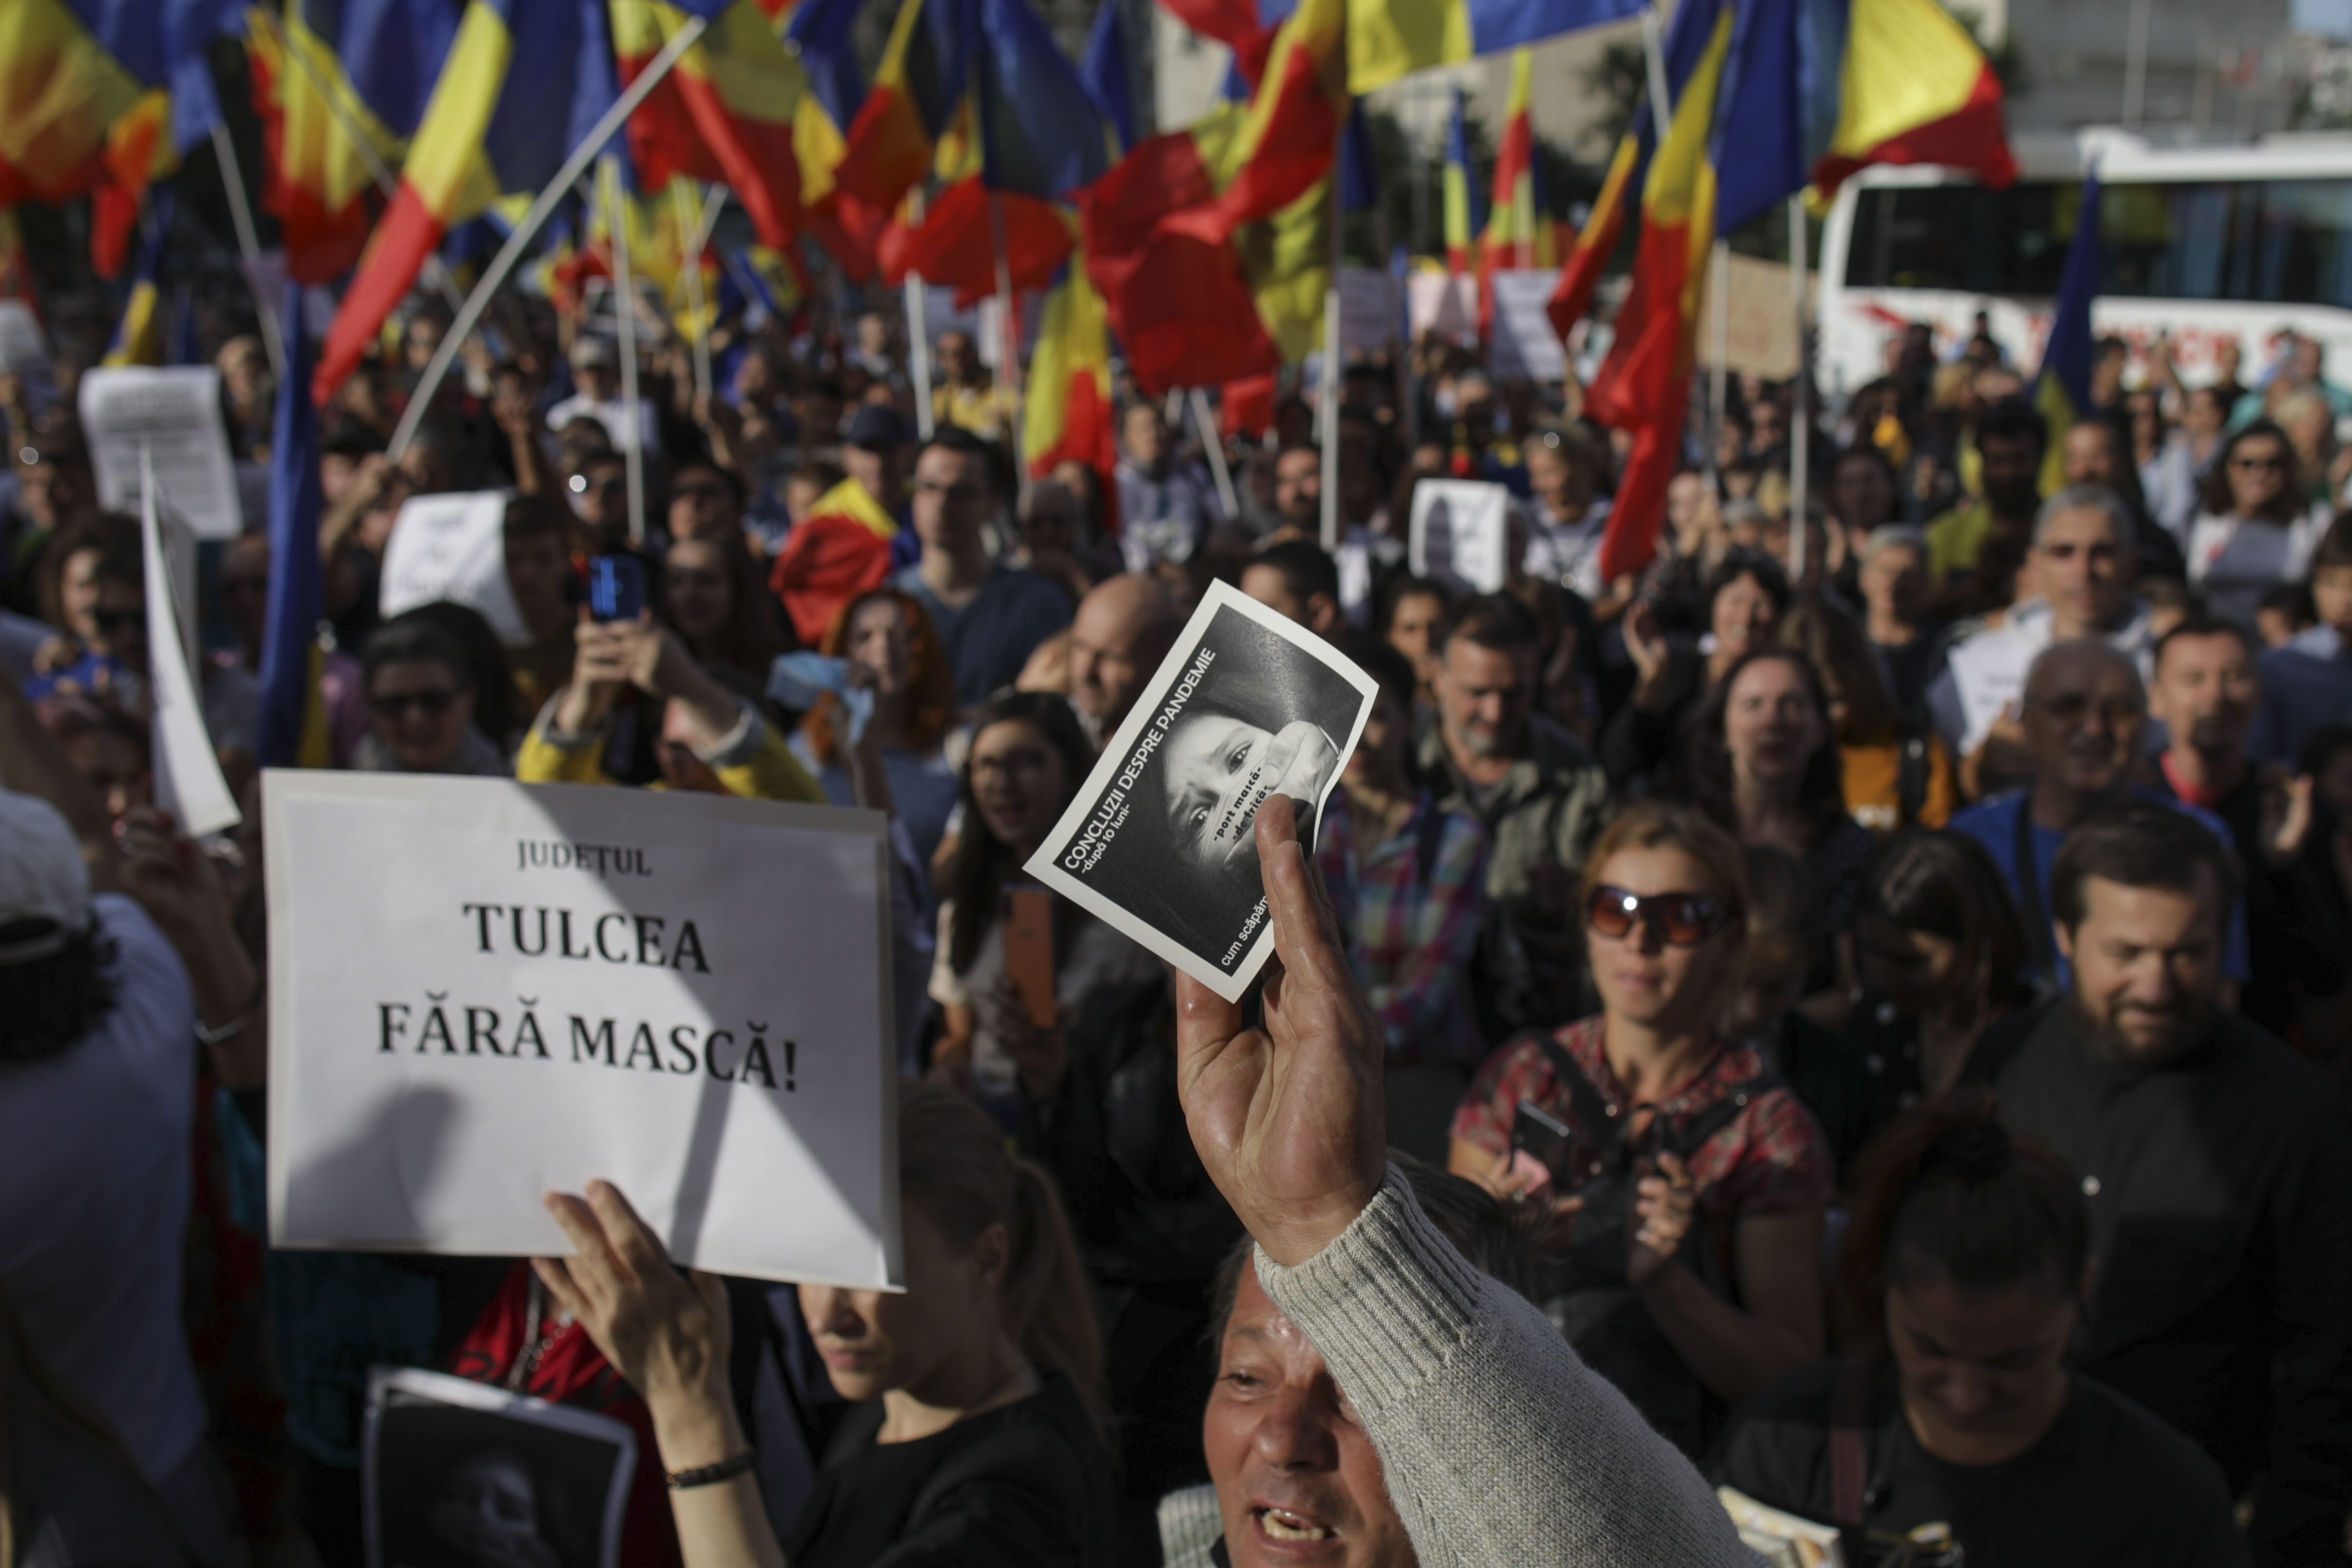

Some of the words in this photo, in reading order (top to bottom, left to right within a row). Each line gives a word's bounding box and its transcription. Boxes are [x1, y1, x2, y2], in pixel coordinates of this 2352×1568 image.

[1065, 788, 1125, 869] CONCLUZII
[1117, 728, 1164, 791] DESPRE
[1156, 647, 1216, 730] PANDEMIE
[1102, 829, 1115, 842] 10
[1110, 804, 1130, 829] luni-
[1214, 810, 1235, 842] -port
[1233, 821, 1248, 840] -de
[462, 902, 710, 974] TULCEA
[1221, 941, 1242, 966] cum
[377, 989, 551, 1060] FĂRĂ
[568, 1014, 797, 1092] MASCĂ!
